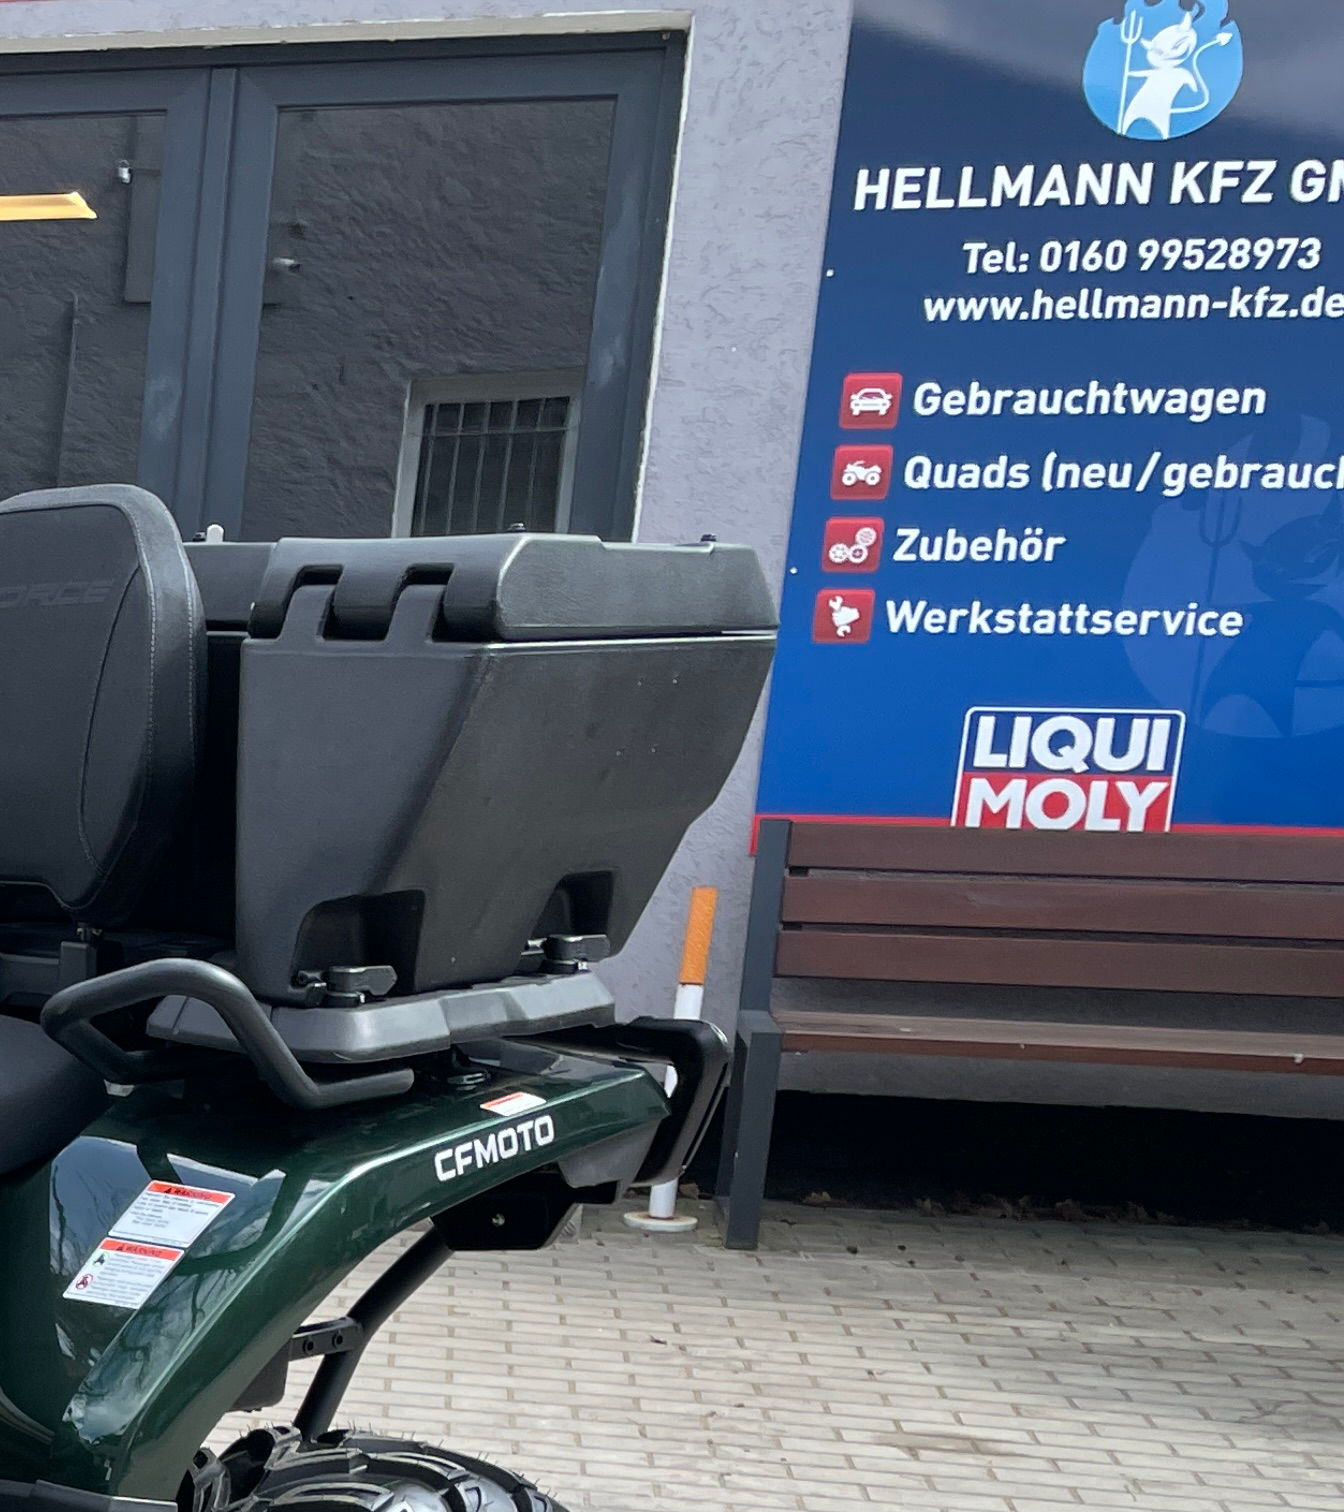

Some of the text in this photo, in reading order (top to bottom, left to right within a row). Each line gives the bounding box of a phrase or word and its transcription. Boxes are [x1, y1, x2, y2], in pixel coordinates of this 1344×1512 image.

[853, 162, 1154, 210] HELLMANN
[1169, 160, 1278, 204] KFZ
[963, 237, 1322, 274] Tel: 0160 99528973
[924, 286, 1344, 321] www.hellmann-kfz.de
[913, 380, 1266, 423] Gebrauchtwagen
[904, 456, 1030, 491] Quads
[892, 527, 1067, 562] Zubehör
[885, 600, 1244, 637] Werkstattservice
[972, 714, 1173, 772] LIQUI
[964, 777, 1170, 832] MOLY
[433, 1114, 555, 1182] CFMOTO
